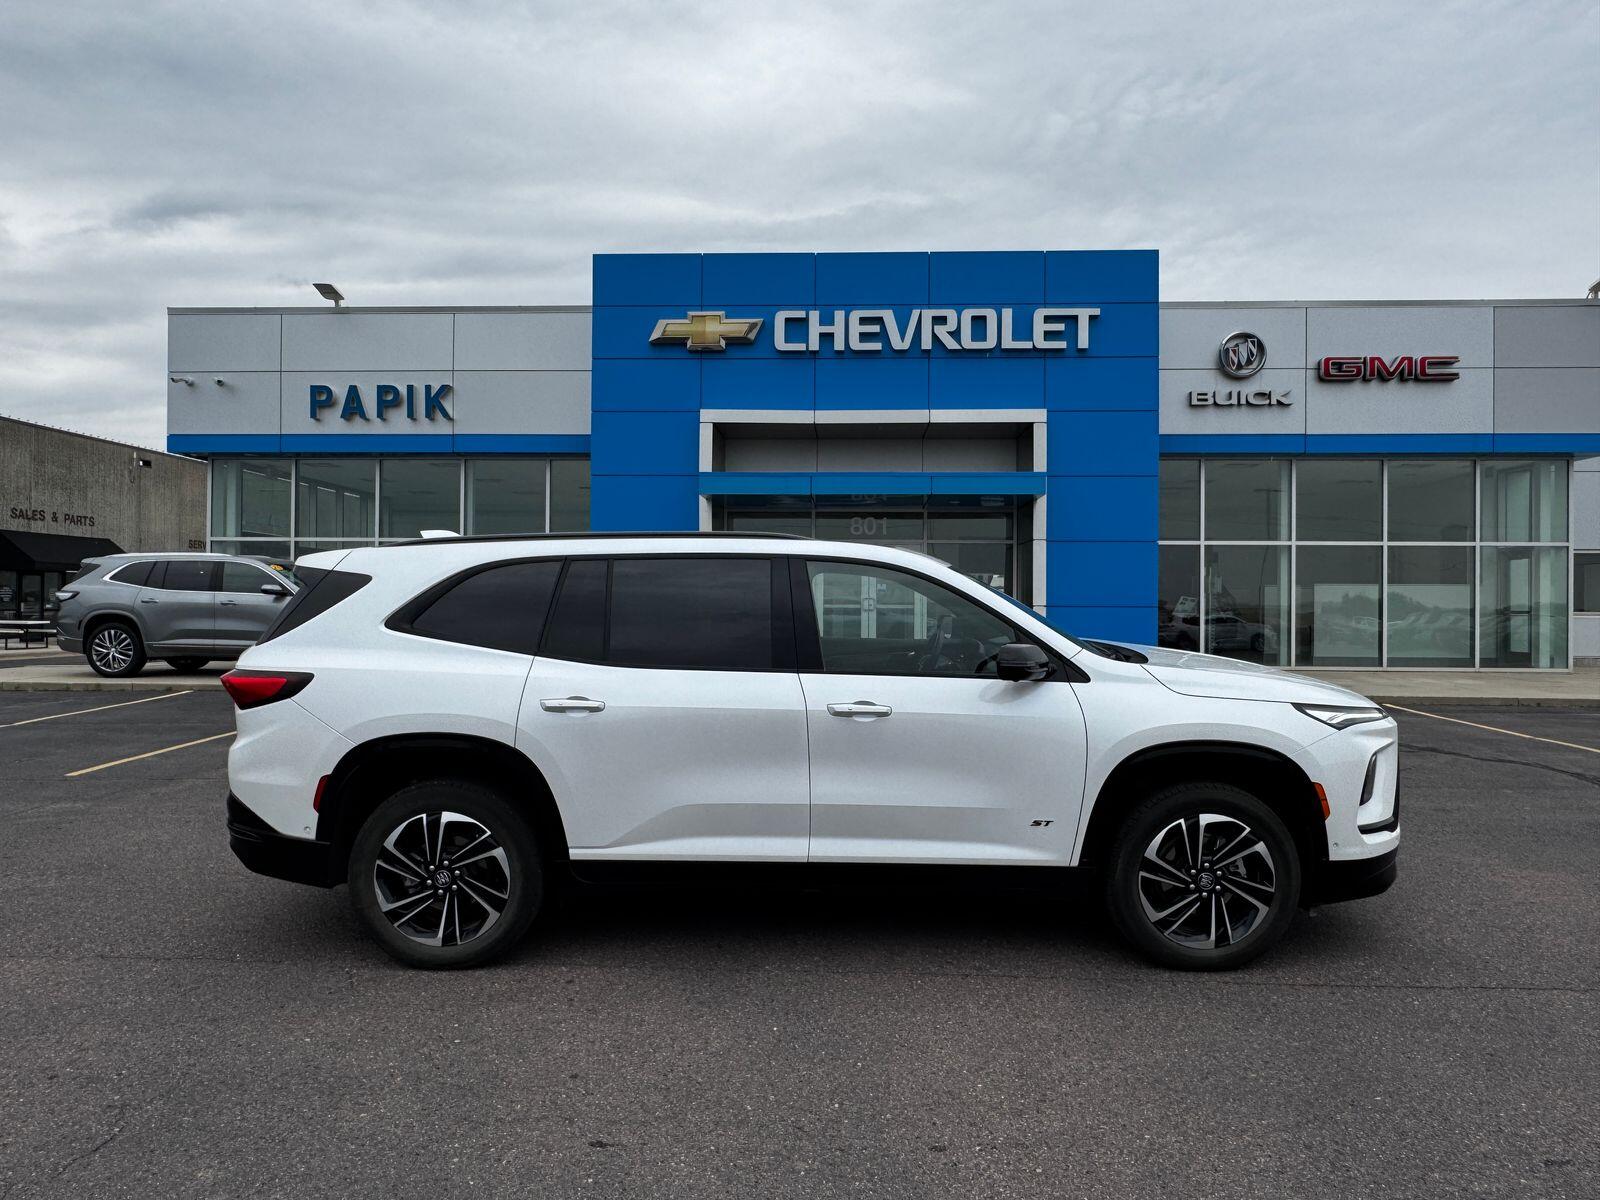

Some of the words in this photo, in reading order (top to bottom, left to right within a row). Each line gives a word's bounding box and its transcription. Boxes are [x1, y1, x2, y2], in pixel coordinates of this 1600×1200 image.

[773, 308, 1101, 351] CHEVROLET
[1318, 355, 1460, 381] GMC
[309, 384, 454, 421] PAPIK
[1190, 390, 1294, 406] BUICK
[10, 507, 46, 521] SALES
[51, 511, 59, 522] &
[64, 513, 95, 526] PARTS
[850, 516, 887, 535] 801
